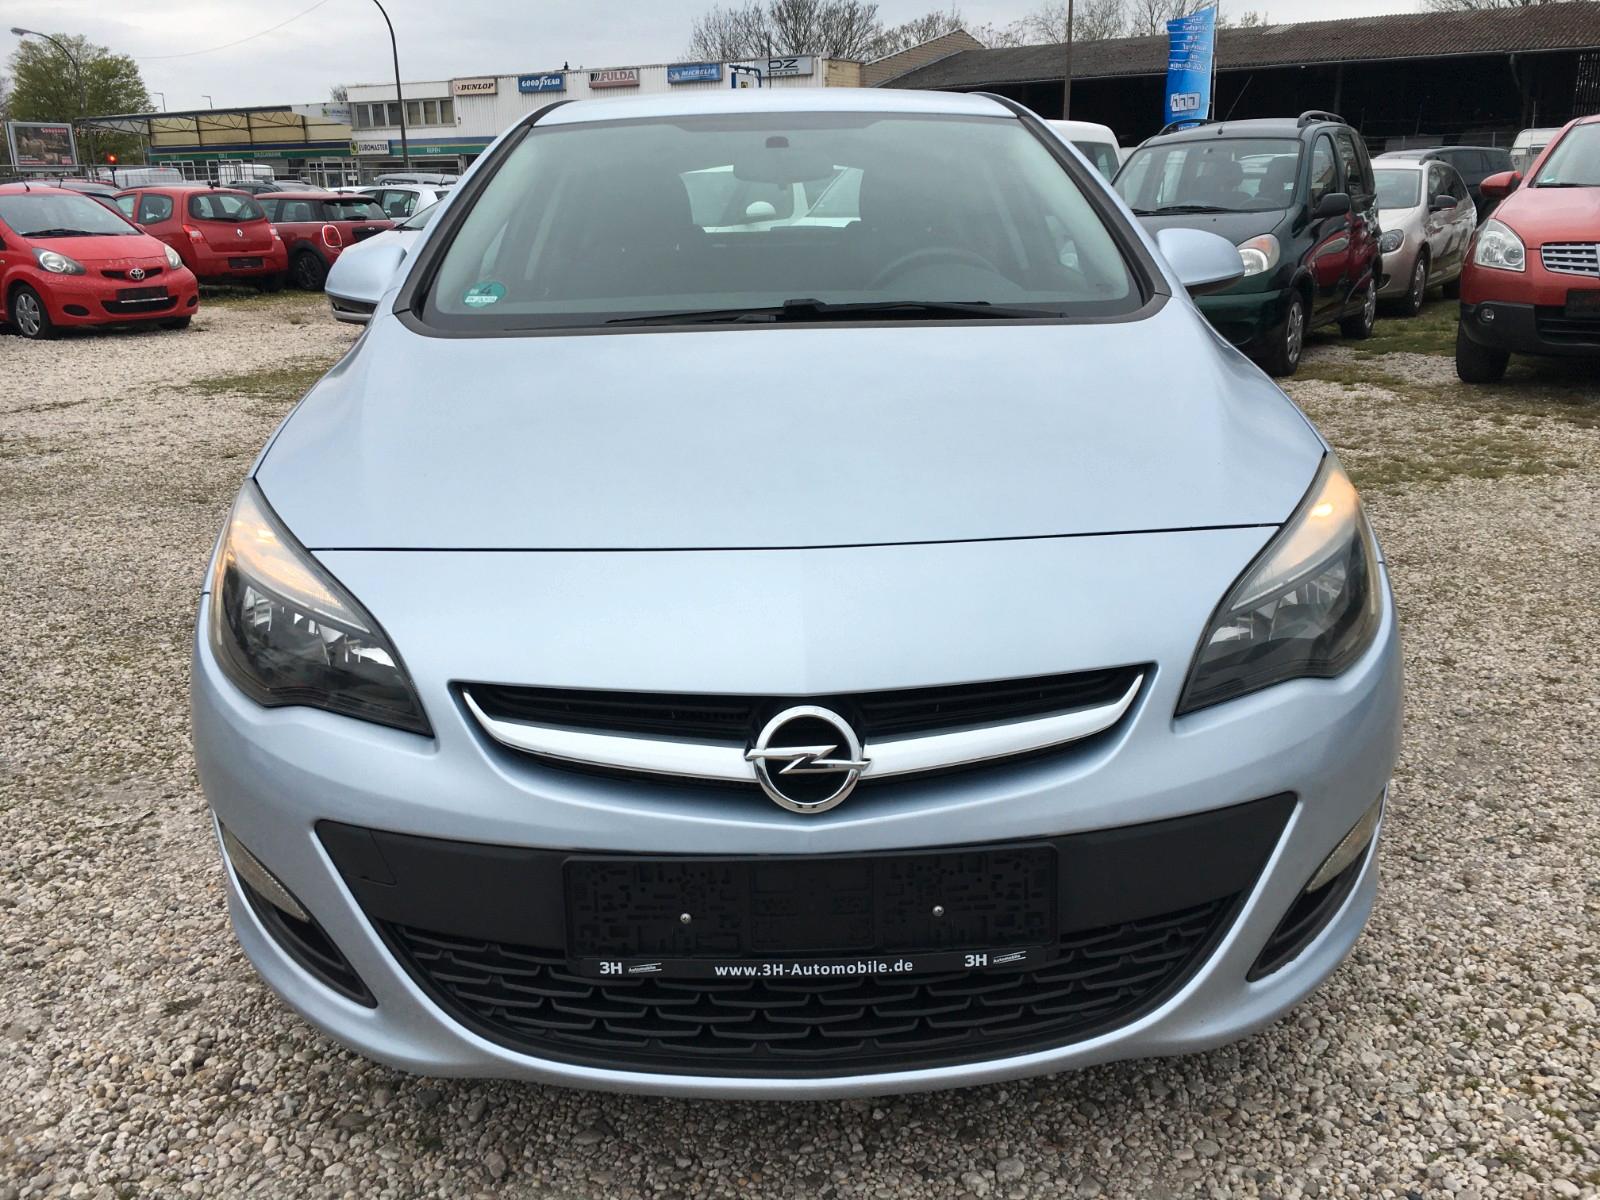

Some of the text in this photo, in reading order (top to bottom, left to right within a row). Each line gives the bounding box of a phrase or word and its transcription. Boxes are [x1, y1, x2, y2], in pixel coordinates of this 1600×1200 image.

[601, 70, 635, 81] FULDA
[681, 68, 717, 77] MICHELIN
[461, 82, 494, 91] DUNLOP
[358, 143, 389, 152] EUROMASTER
[964, 954, 988, 967] 3H
[599, 962, 623, 975] 3H
[714, 959, 914, 976] www.3H-Automobile.de
